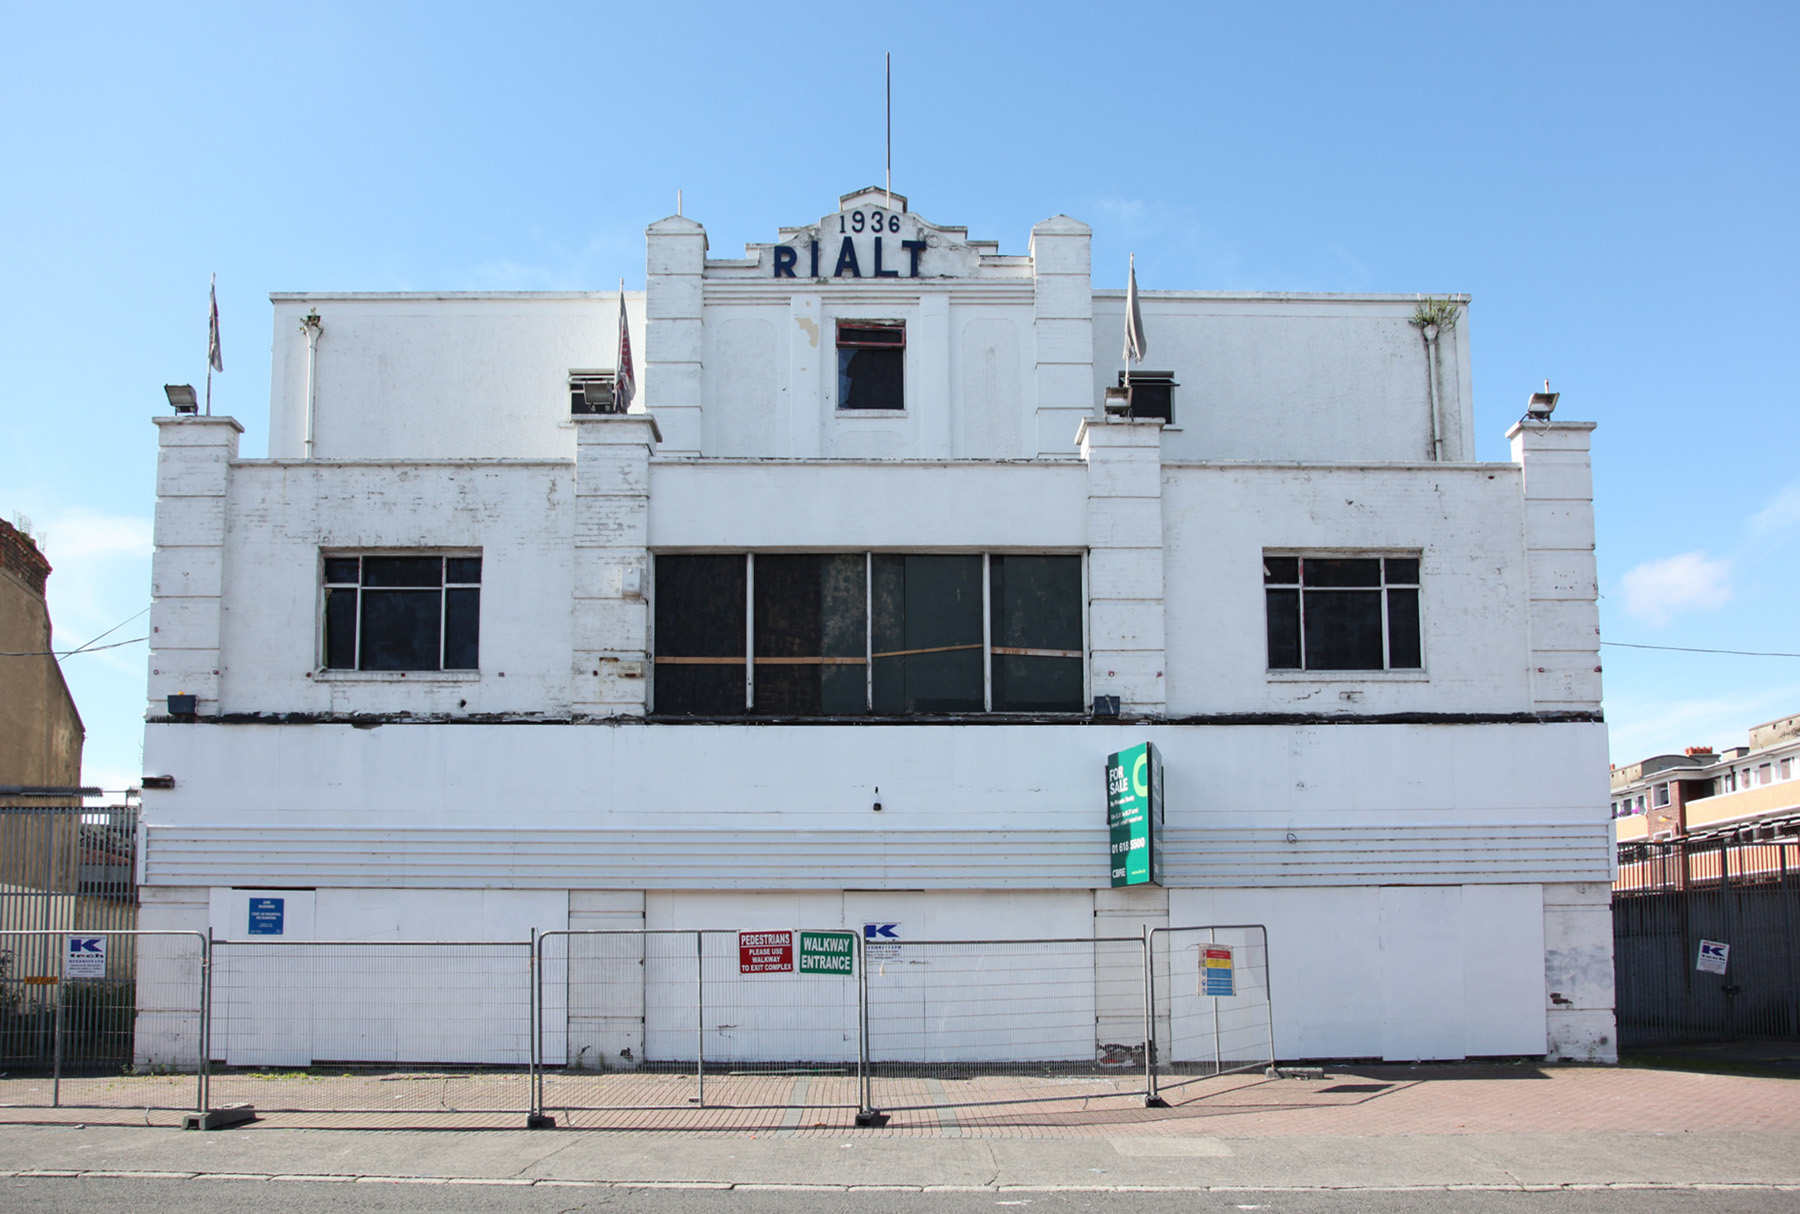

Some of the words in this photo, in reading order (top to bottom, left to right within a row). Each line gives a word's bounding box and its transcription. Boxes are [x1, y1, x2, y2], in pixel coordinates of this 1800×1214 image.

[839, 210, 900, 233] 1936
[774, 236, 927, 278] RIALT
[1109, 765, 1124, 782] FOR
[1110, 777, 1129, 795] SALE
[1111, 844, 1118, 854] 01
[1119, 841, 1129, 853] 618
[1112, 867, 1126, 879] CBRE
[741, 933, 791, 946] PEDESTRIANS
[803, 937, 850, 953] WALKWAY
[749, 948, 770, 956] PLEASE
[741, 964, 750, 972] TO
[750, 964, 764, 972] EXIT
[764, 963, 792, 971] COMPLEX
[801, 954, 851, 970] ENTRANCE
